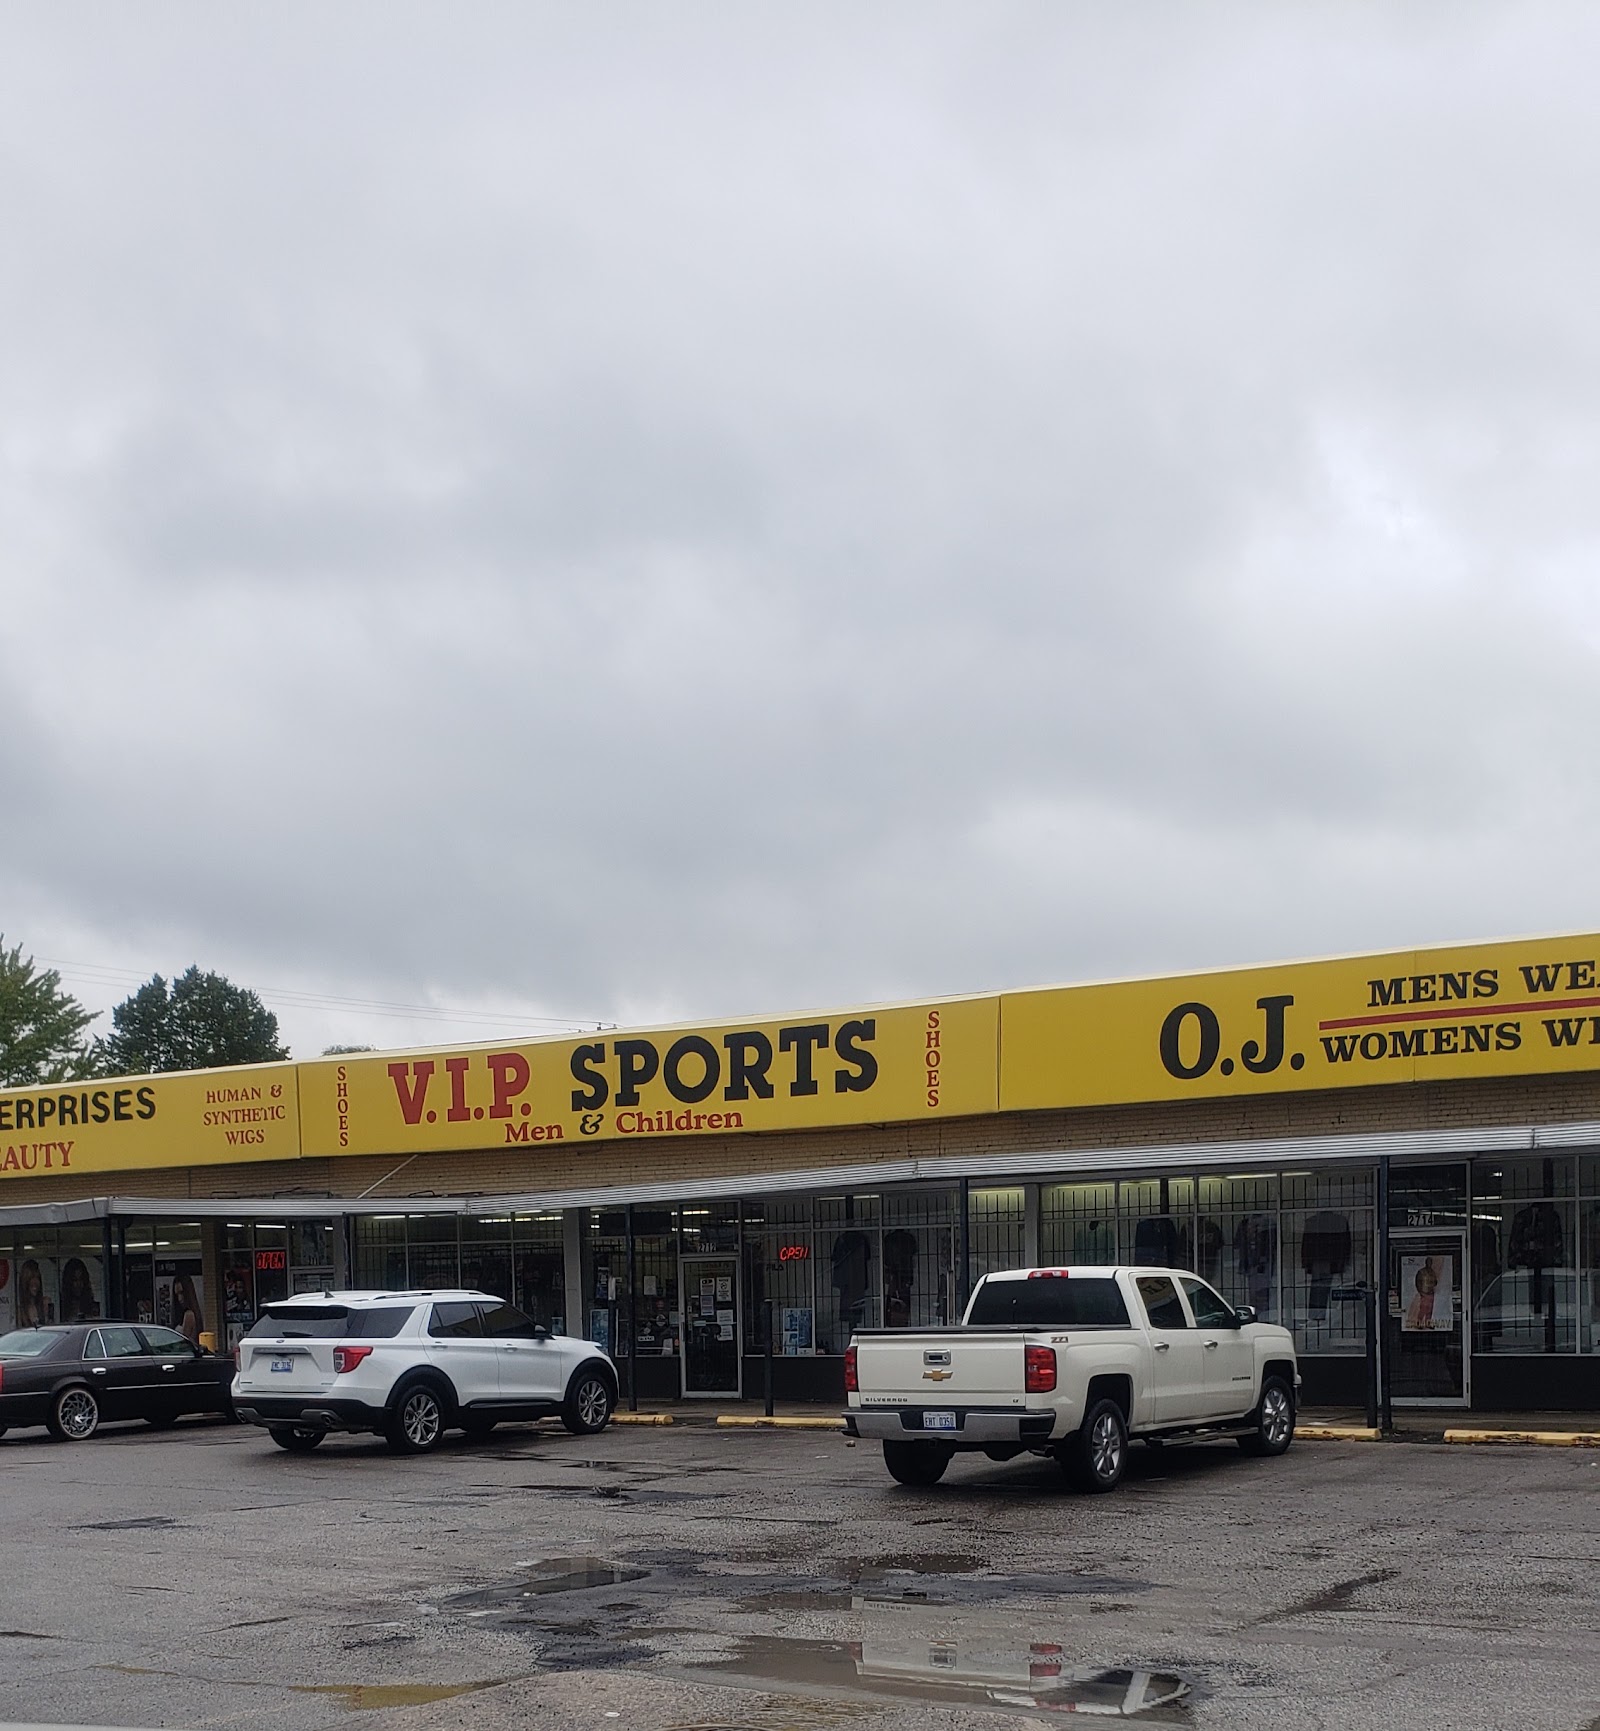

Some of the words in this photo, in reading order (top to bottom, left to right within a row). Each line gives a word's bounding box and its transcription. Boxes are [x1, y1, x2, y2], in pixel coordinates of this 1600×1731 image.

[1367, 969, 1499, 1007] MENS
[1518, 960, 1600, 994] WE
[1159, 995, 1305, 1079] O.J.
[1319, 1021, 1522, 1063] WOMENS
[387, 1052, 532, 1124] V.I.P.
[570, 1019, 878, 1112] SPORTS
[925, 1011, 941, 1107] SHOES
[0, 1087, 156, 1130] ERPRISES
[206, 1087, 262, 1104] HUMAN
[270, 1084, 283, 1098] &
[337, 1066, 349, 1147] SHOES
[203, 1105, 286, 1126] SYNTHETIC
[504, 1122, 564, 1143] Men
[579, 1114, 604, 1135] &
[616, 1109, 743, 1134] Children
[225, 1129, 265, 1145] WIGS
[0, 1141, 75, 1171] AUTY
[1408, 1215, 1433, 1226] 2714
[256, 1251, 285, 1269] OPEN
[698, 1243, 717, 1252] 2712
[779, 1246, 808, 1261] OPEN
